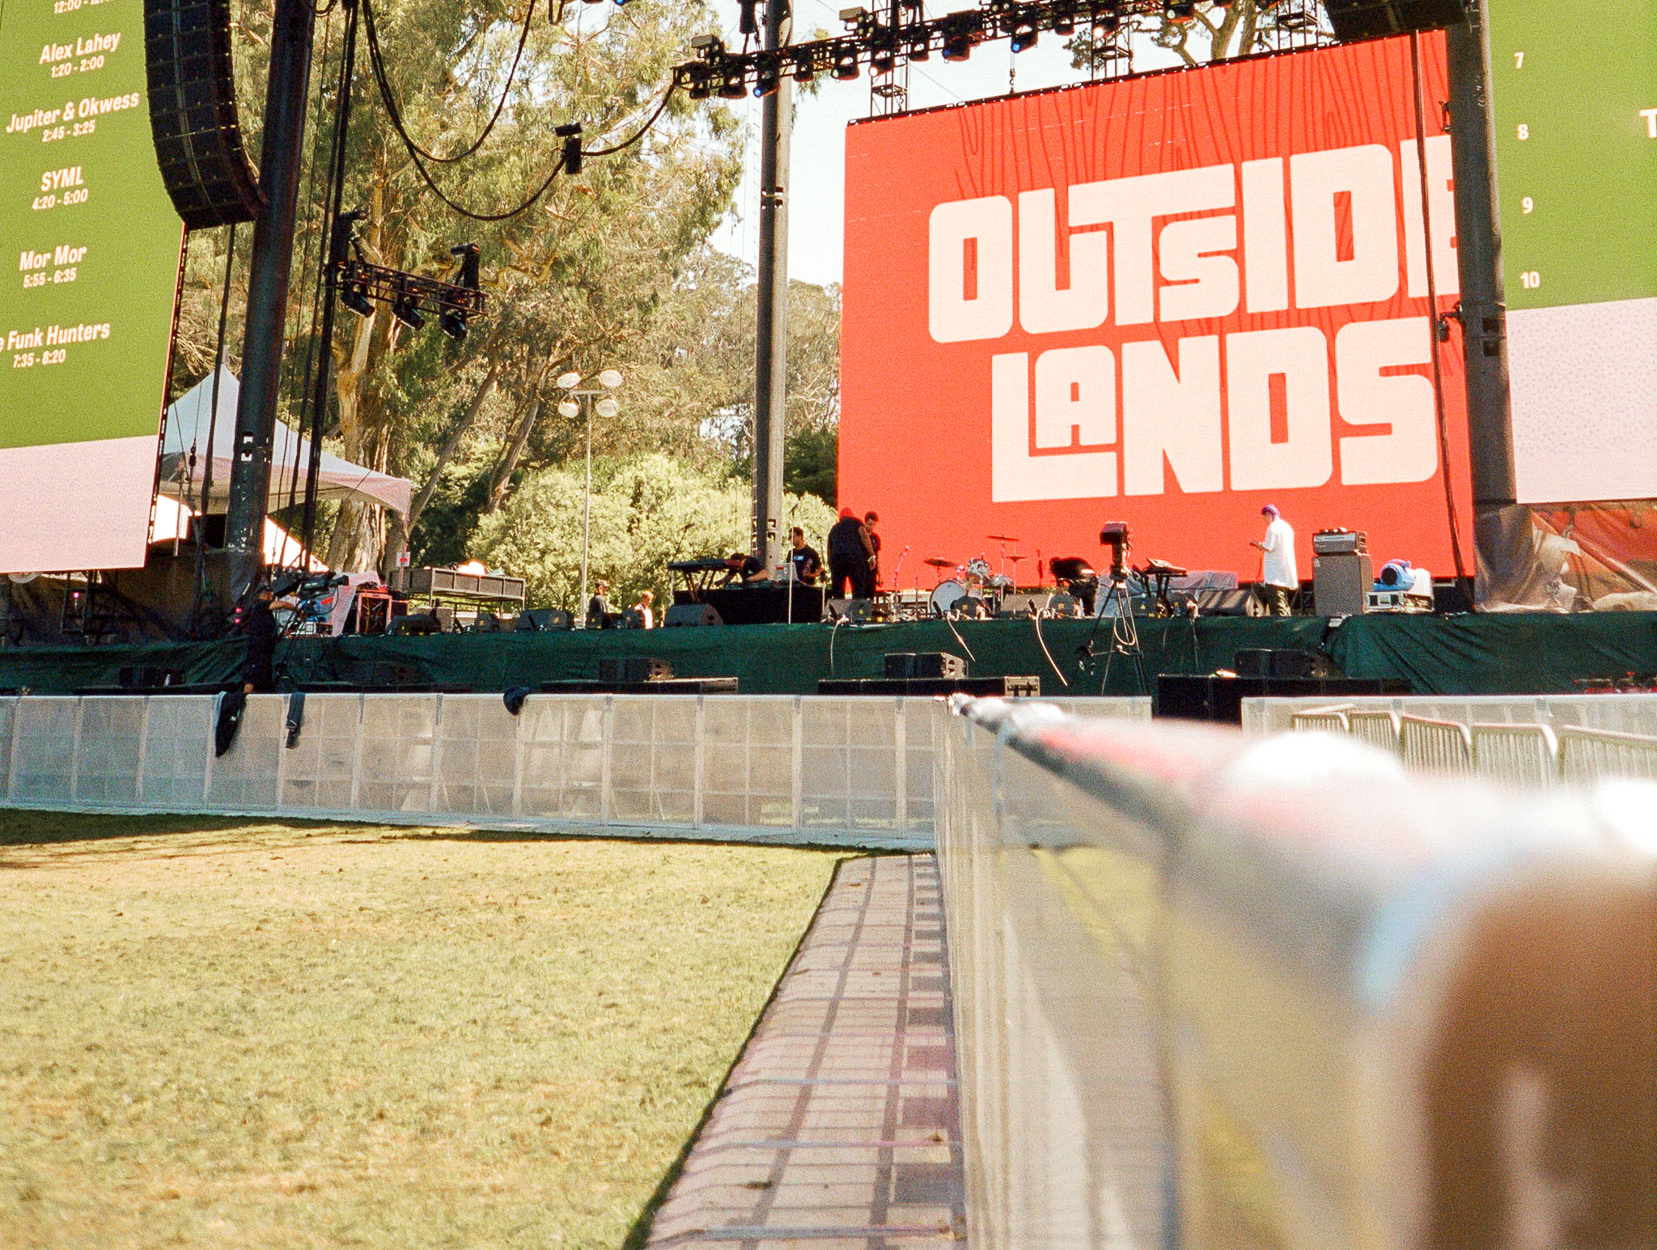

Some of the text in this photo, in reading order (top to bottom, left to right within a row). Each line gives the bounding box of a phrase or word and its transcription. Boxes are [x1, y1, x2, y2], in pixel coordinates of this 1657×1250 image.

[39, 32, 121, 64] Alex Lahey
[51, 62, 72, 78] 1:20
[80, 55, 105, 72] 2:00
[1514, 52, 1525, 69] 7
[6, 92, 140, 133] Jupiter & Okwess
[42, 126, 65, 143] 2:45
[73, 120, 96, 136] 3:25
[1517, 124, 1529, 140] 8
[40, 165, 84, 191] SYML
[32, 194, 55, 211] 4:20
[63, 188, 89, 206] 5:00
[1522, 197, 1533, 214] 9
[19, 244, 88, 271] Mor Mor
[23, 271, 46, 288] 5:55
[53, 267, 77, 284] 6:35
[1521, 272, 1541, 288] 10
[7, 327, 44, 351] Funk
[46, 323, 111, 346] Hunters
[13, 352, 34, 368] 7:35
[42, 348, 66, 365] 8:20
[992, 316, 1438, 503] LANDS
